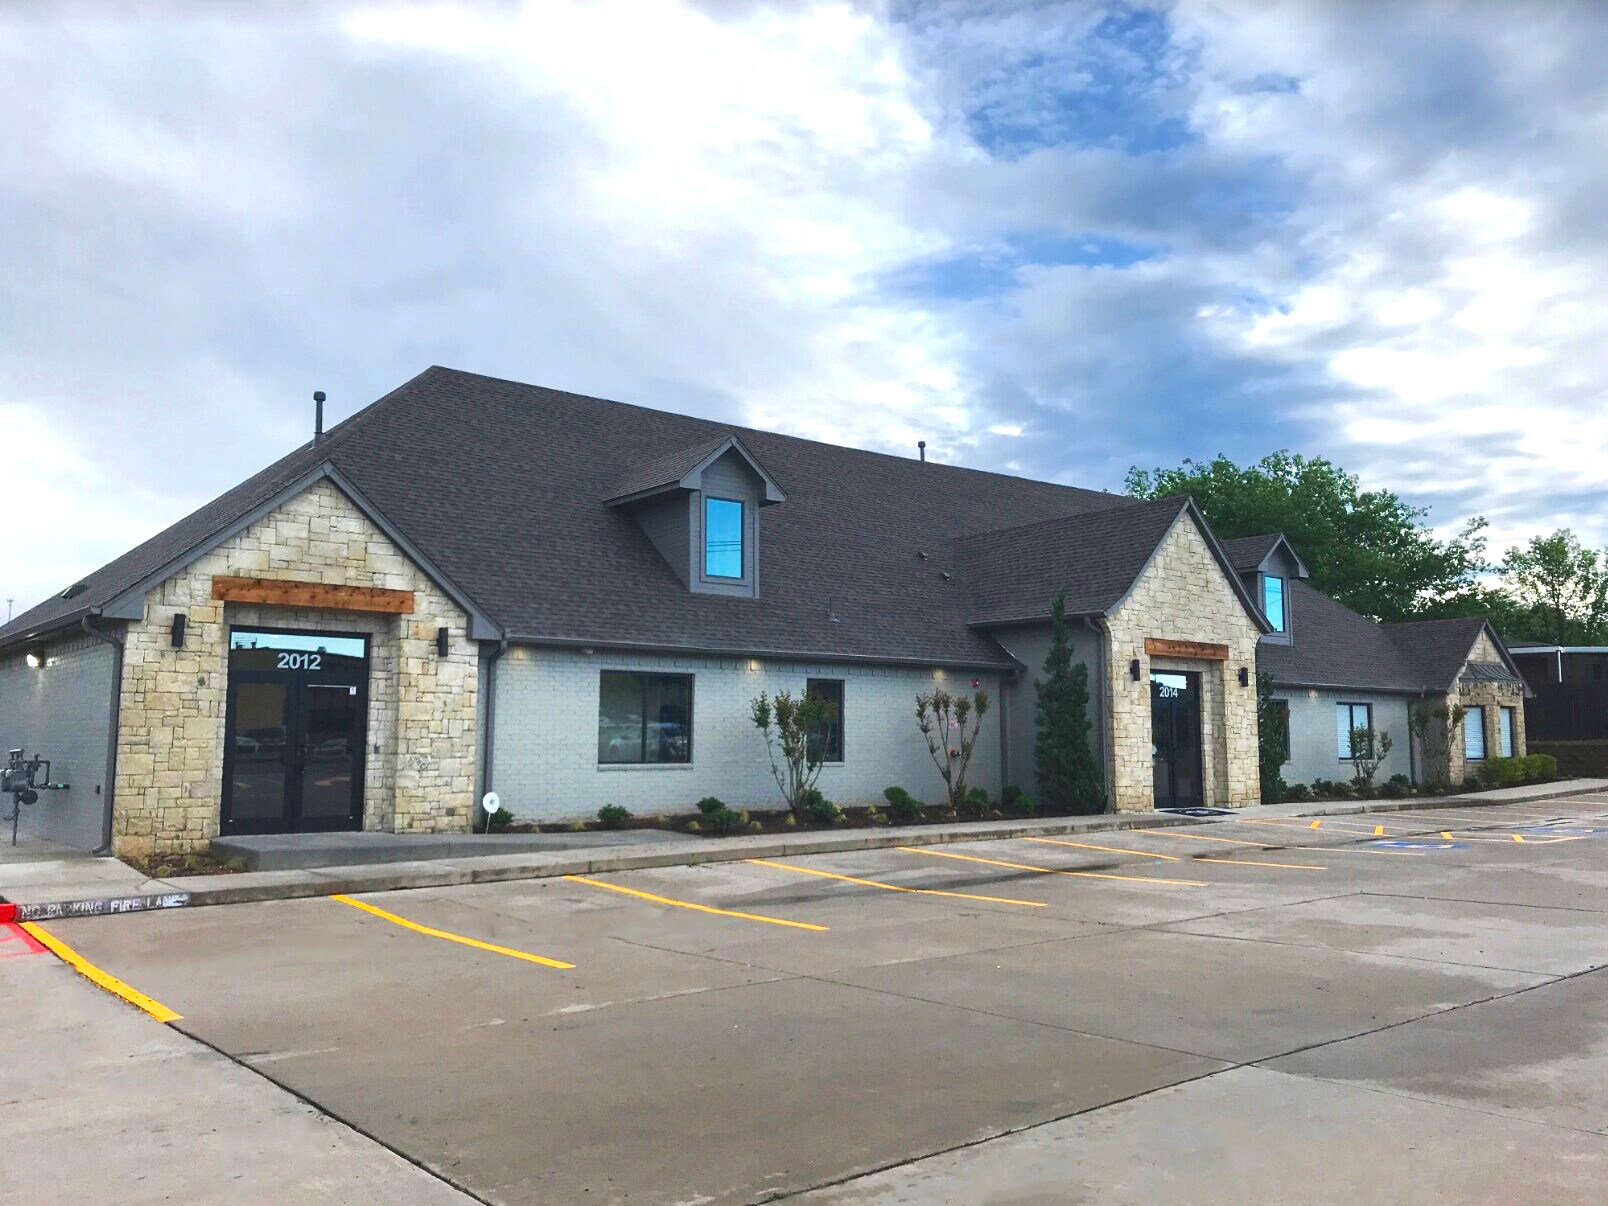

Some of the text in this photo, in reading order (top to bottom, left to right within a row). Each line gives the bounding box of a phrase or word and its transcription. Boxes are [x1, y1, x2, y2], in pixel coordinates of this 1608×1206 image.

[277, 653, 321, 670] 2012
[1159, 686, 1179, 698] 2014
[21, 904, 41, 919] NO
[110, 898, 141, 913] FIRE
